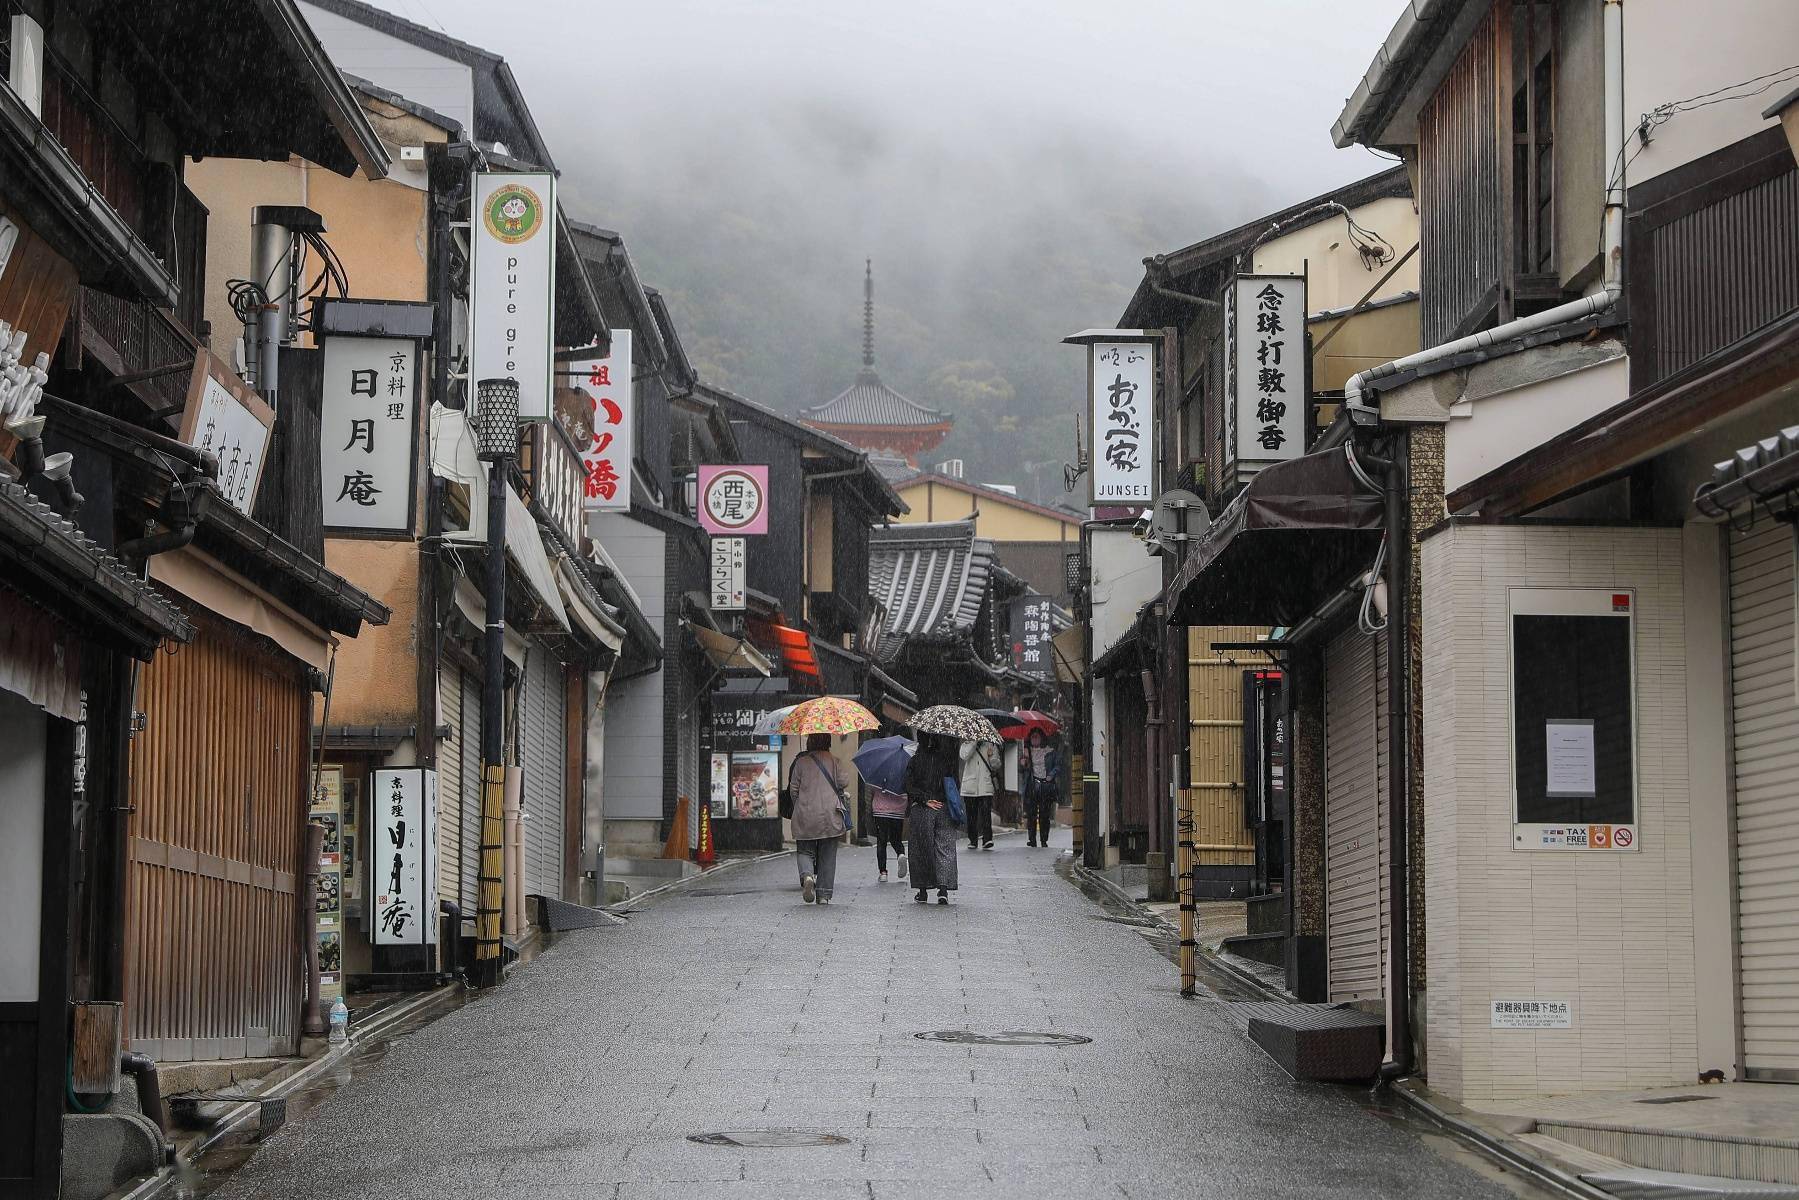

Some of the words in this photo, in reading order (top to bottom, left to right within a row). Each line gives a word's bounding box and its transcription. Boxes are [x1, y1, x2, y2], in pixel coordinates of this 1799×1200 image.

[507, 257, 517, 313] pure
[386, 352, 406, 420] 京料理
[1256, 284, 1287, 451] 念珠・打敷・御香
[336, 369, 383, 506] 日月庵
[1105, 374, 1140, 473] おかべ家
[721, 480, 744, 519] 西尾
[745, 489, 756, 510] 本家
[1099, 485, 1149, 496] JUNSEI
[716, 541, 728, 605] こうらく堂
[391, 777, 403, 817] 京料理
[381, 820, 412, 938] 日月庵
[1495, 1002, 1567, 1013] 避難器具降下地点
